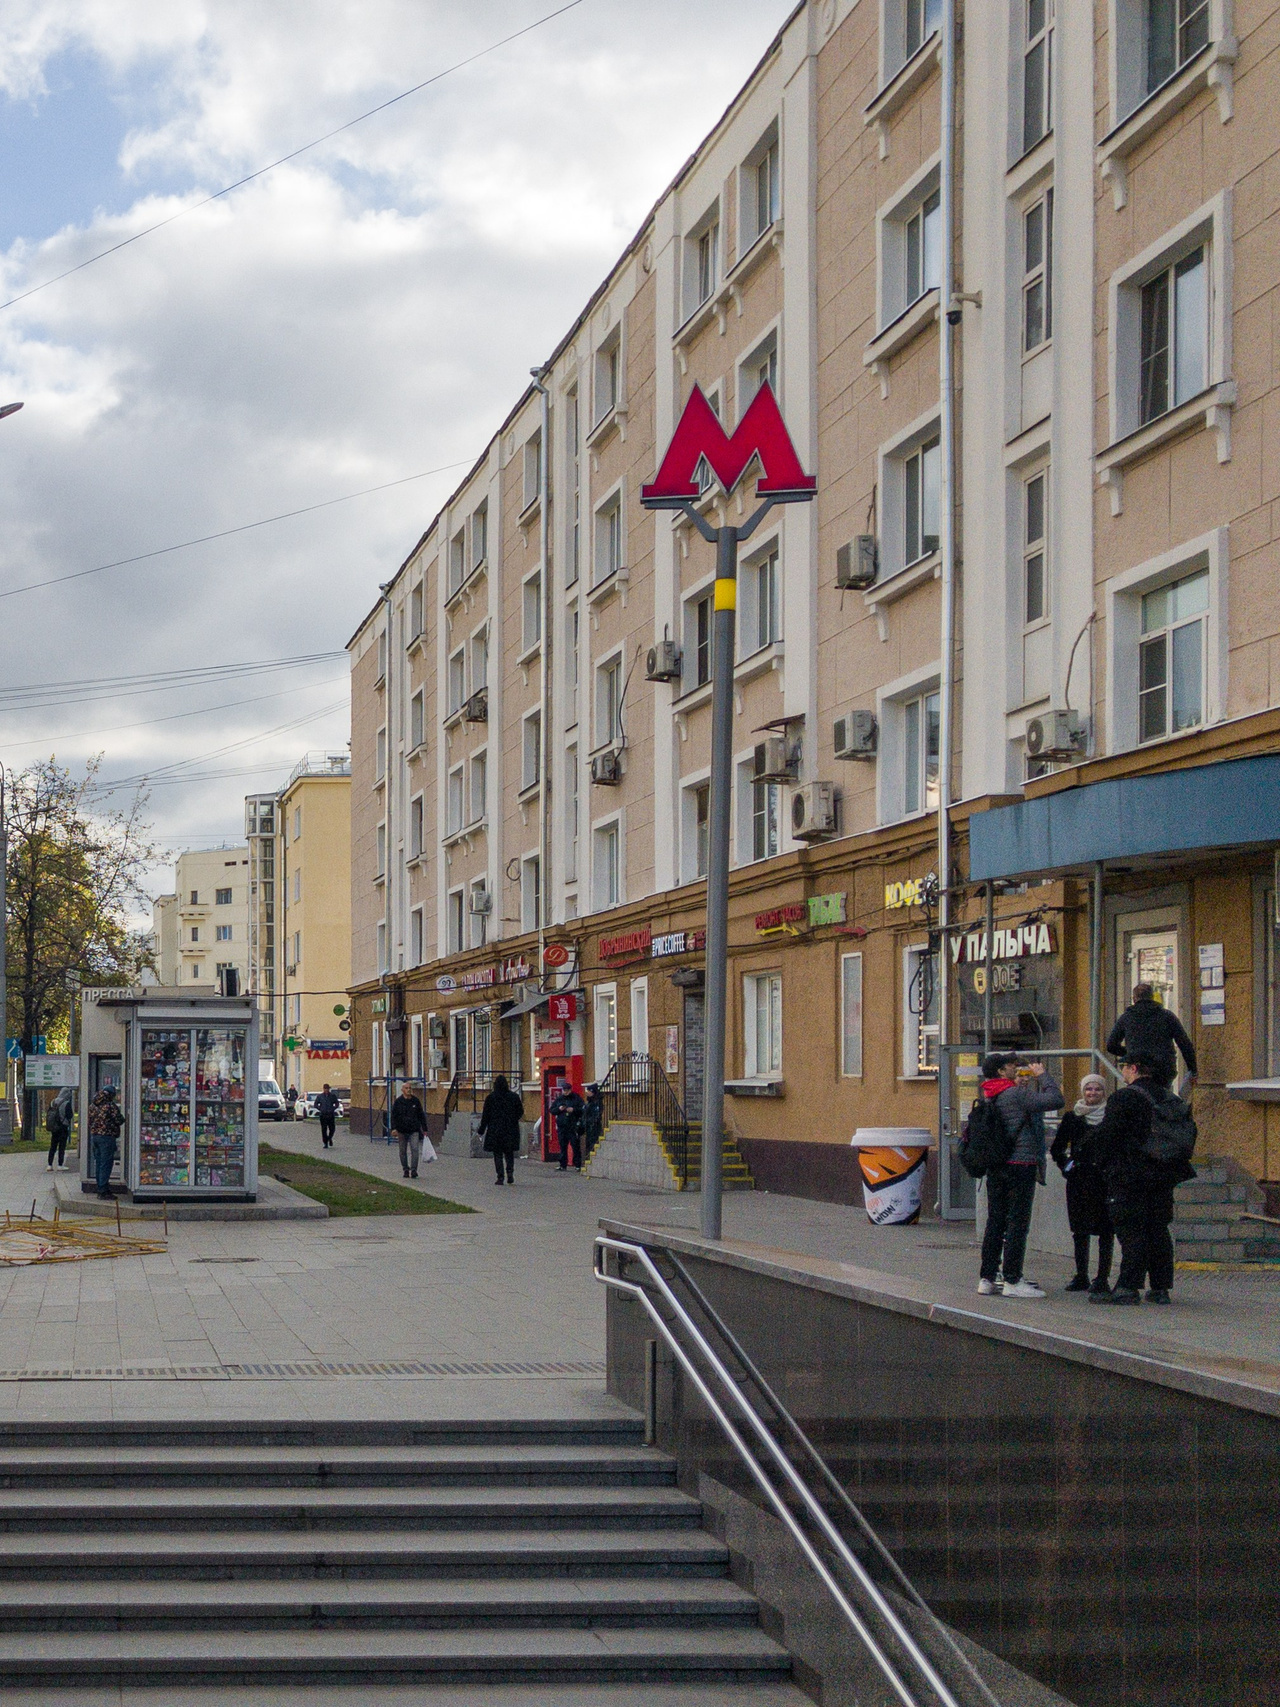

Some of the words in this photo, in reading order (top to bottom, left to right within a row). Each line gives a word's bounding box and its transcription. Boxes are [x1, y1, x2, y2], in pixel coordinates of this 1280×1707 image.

[640, 378, 817, 499] М
[885, 878, 923, 909] КОФЕ
[950, 936, 962, 963] У
[967, 924, 1051, 961] ПАЛЫЧА
[83, 989, 134, 1001] ПРЕССА
[306, 1049, 350, 1060] ТАБАК
[875, 1204, 896, 1223] WOW
